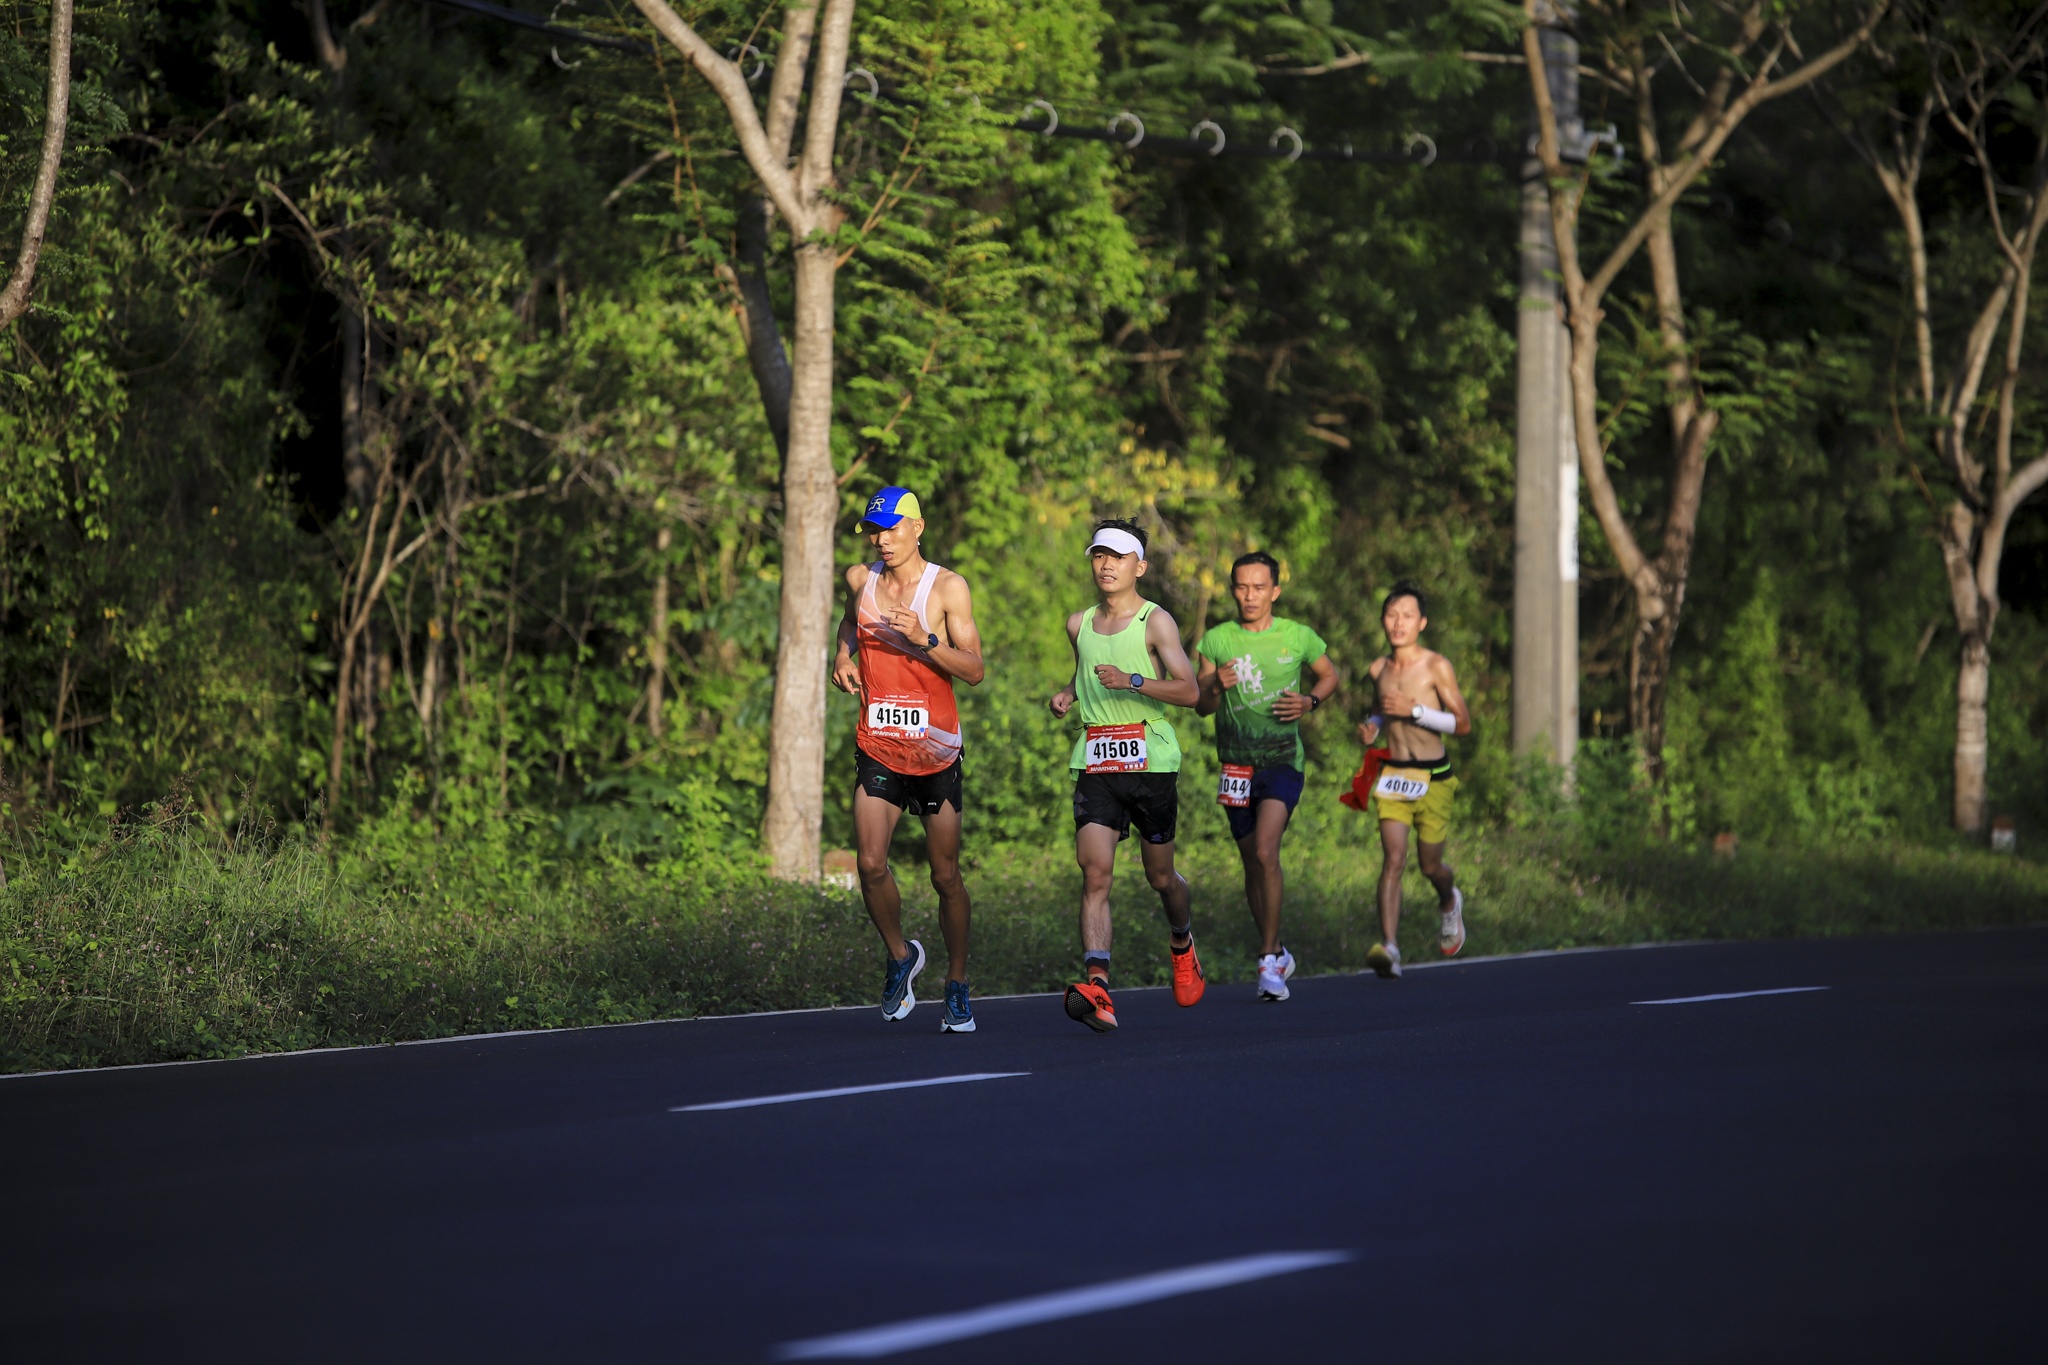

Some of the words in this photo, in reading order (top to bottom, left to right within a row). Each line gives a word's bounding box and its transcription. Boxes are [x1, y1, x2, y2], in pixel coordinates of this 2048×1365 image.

[876, 707, 920, 726] 41510
[1093, 740, 1140, 759] 41508
[1385, 779, 1424, 795] 40077
